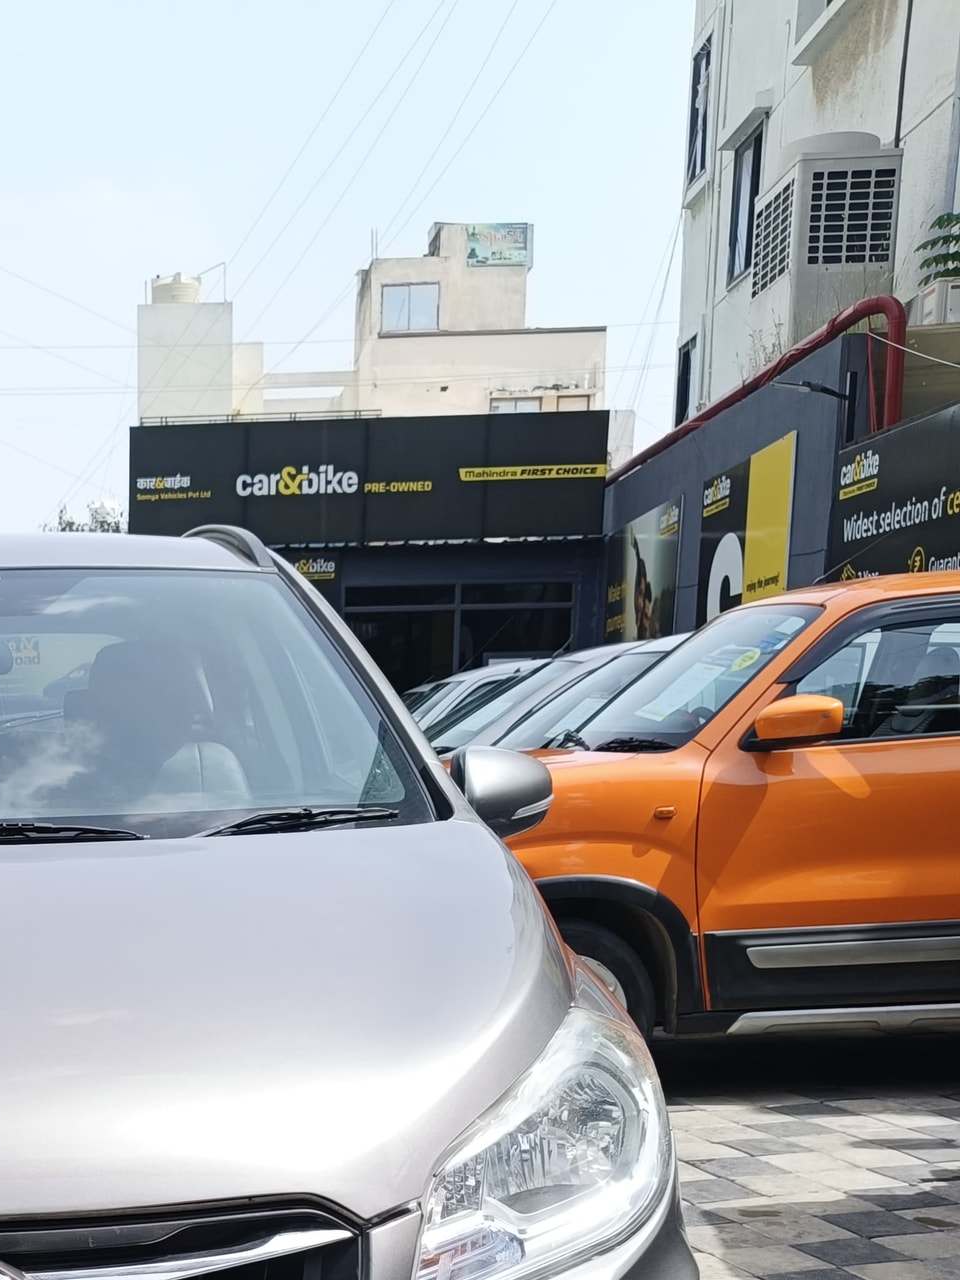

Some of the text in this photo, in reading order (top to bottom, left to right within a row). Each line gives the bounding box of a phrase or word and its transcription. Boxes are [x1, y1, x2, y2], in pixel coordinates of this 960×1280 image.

[465, 467, 598, 478] Mahindra FIRST CHOICE
[840, 450, 879, 486] car&bike
[236, 464, 359, 497] car&bike
[364, 481, 432, 493] PRE-OWNED
[200, 490, 211, 498] Ltd
[704, 475, 731, 506] car&bike
[844, 511, 878, 542] Widest
[879, 497, 929, 533] selection
[931, 486, 947, 519] of
[293, 557, 335, 573] r&bike
[14, 652, 40, 666] oad
